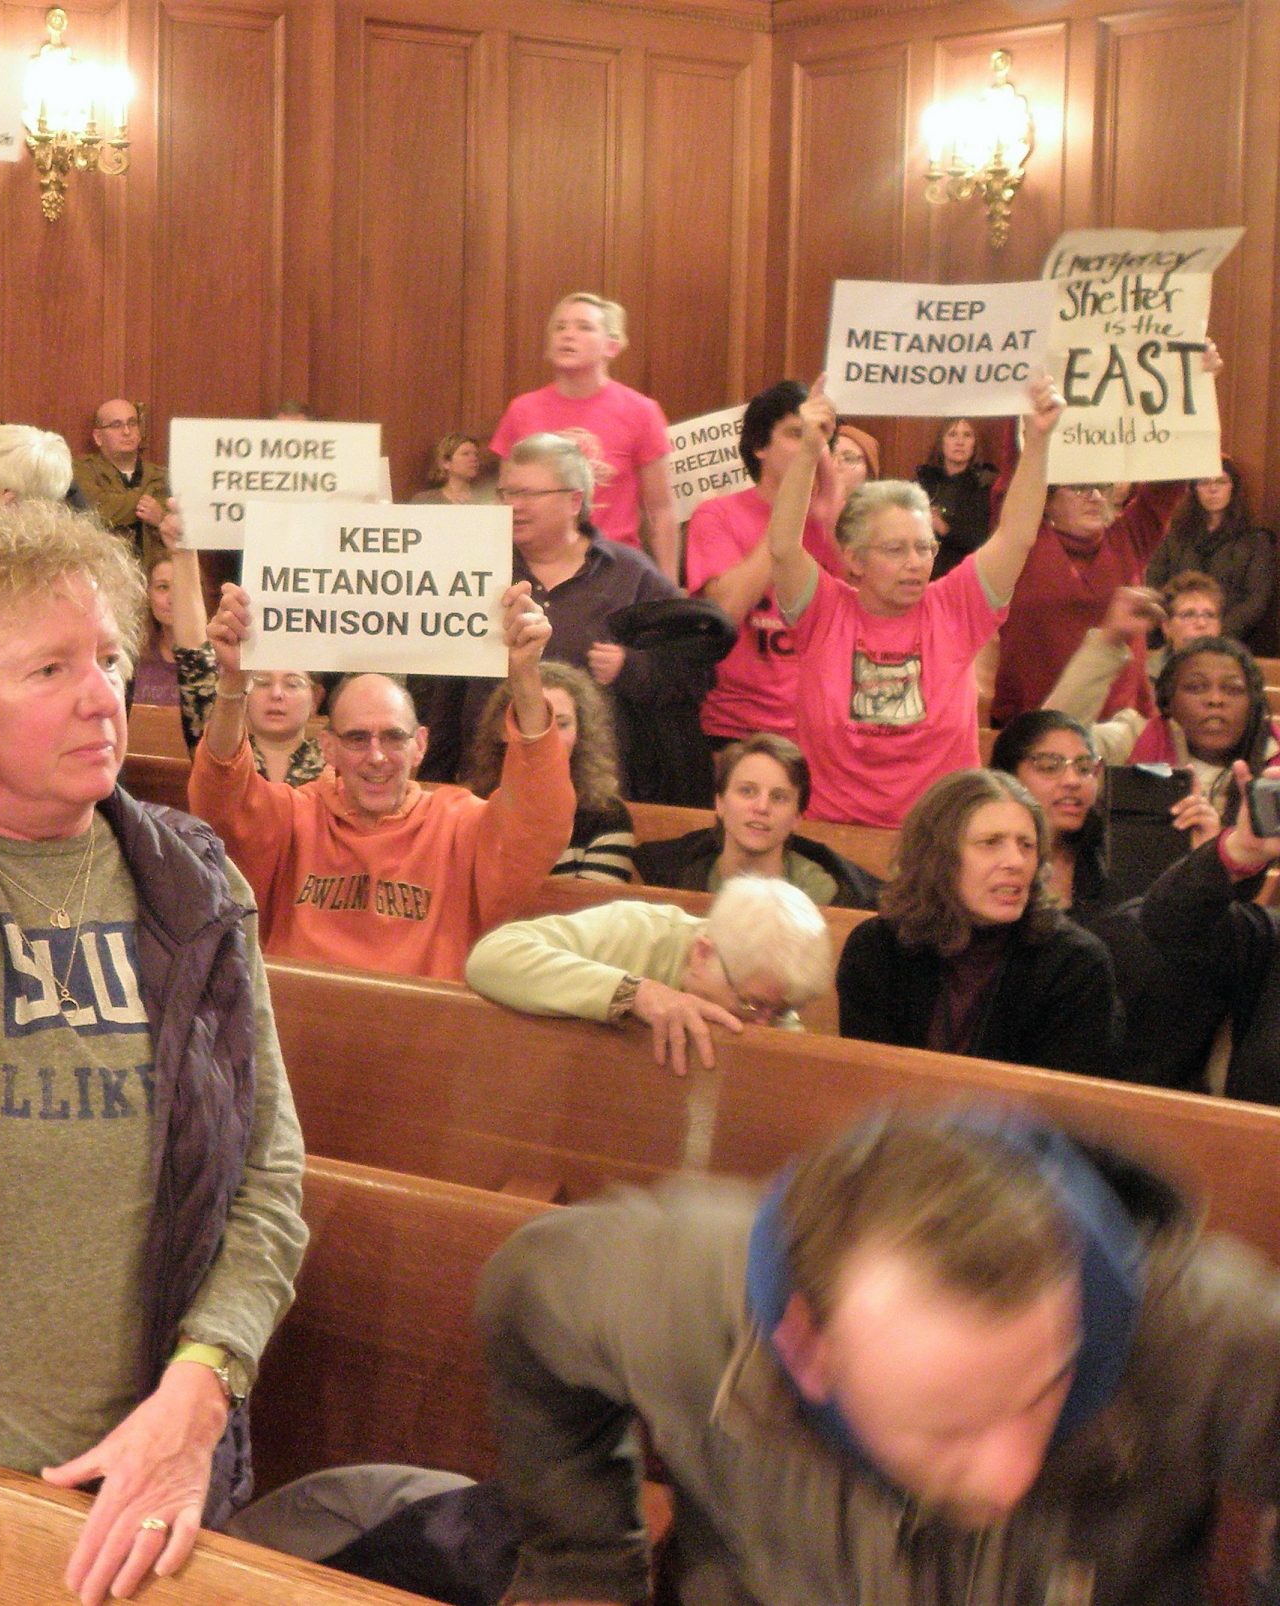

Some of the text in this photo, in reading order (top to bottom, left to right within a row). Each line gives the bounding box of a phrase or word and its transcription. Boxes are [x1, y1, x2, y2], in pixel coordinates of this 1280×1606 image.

[916, 300, 986, 321] KEEP
[1059, 274, 1183, 321] Shelter
[1104, 315, 1184, 338] is the
[846, 327, 1037, 353] METANOIA AT
[845, 361, 1030, 385] DENISON UCC
[691, 419, 744, 446] MORE
[1063, 416, 1170, 445] should do
[215, 438, 337, 460] NO MORE
[670, 445, 742, 475] REEZIN
[212, 470, 338, 493] FREEZING
[672, 481, 694, 499] TO
[210, 502, 245, 523] TO
[339, 526, 422, 553] KEEP
[261, 565, 493, 598] METANOIA AT
[262, 606, 489, 638] DENISON UCC
